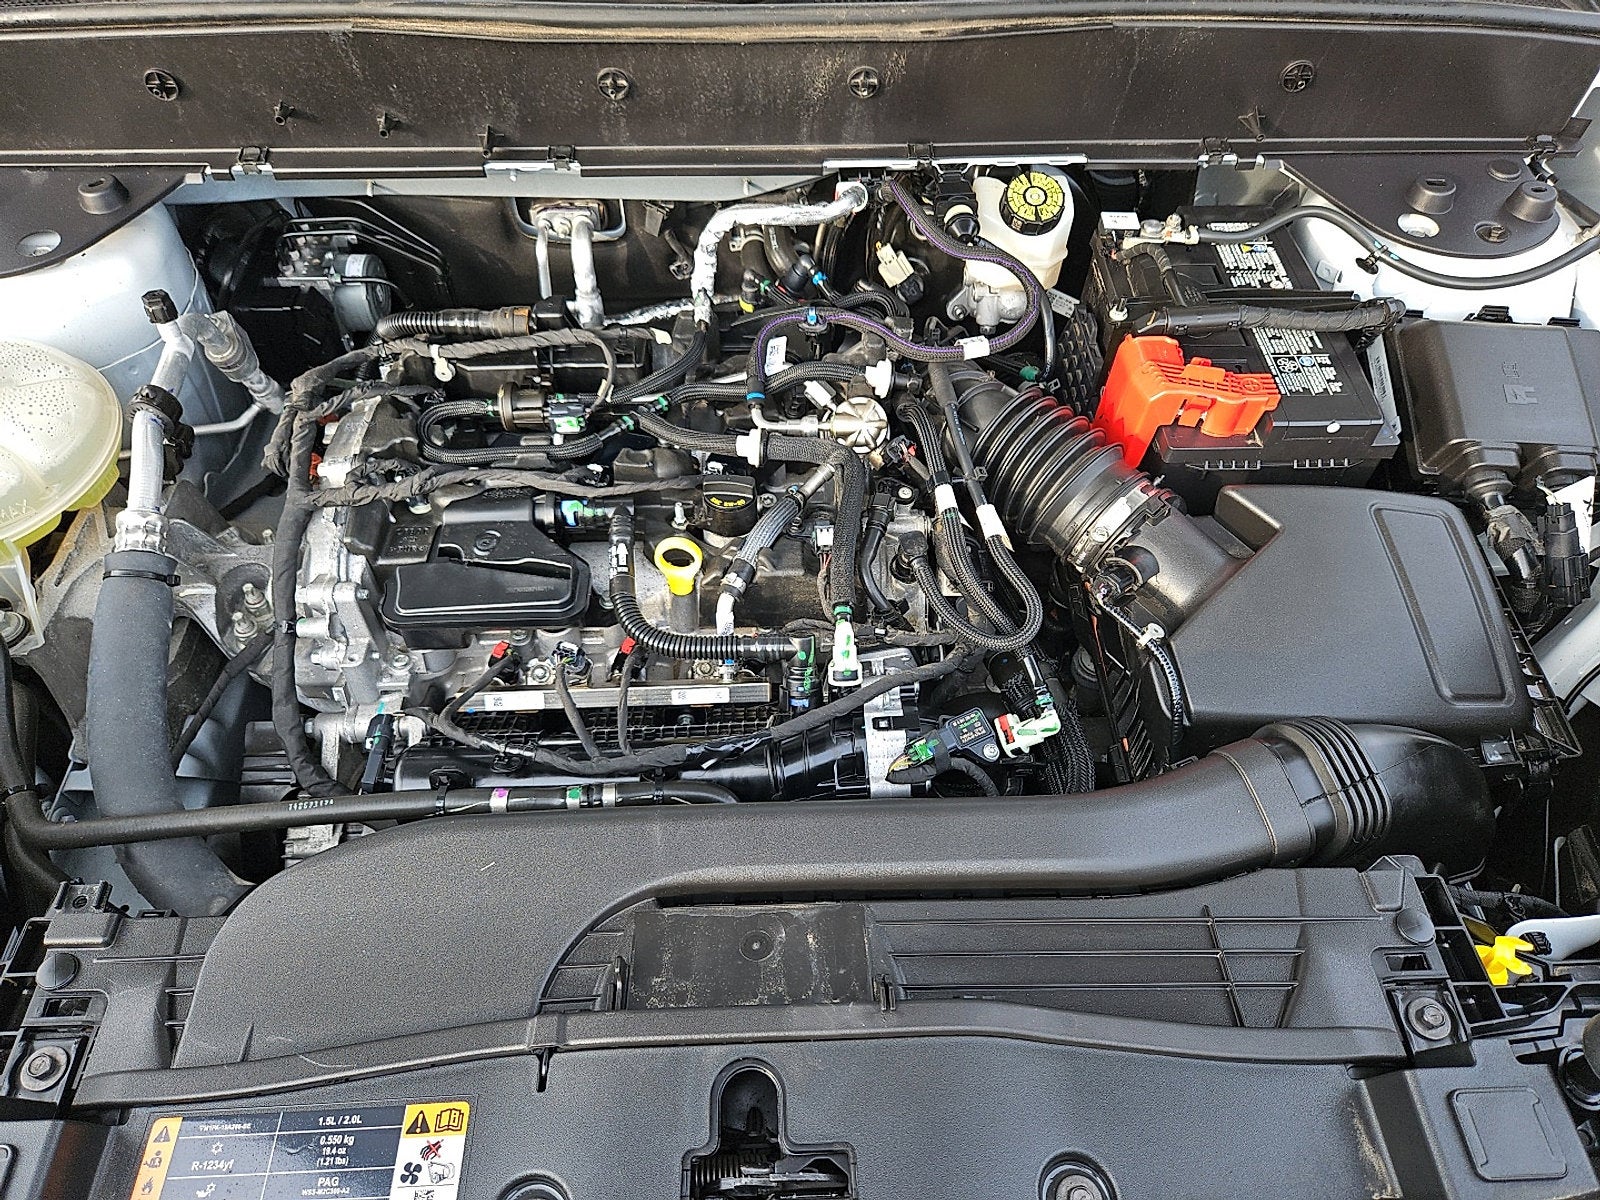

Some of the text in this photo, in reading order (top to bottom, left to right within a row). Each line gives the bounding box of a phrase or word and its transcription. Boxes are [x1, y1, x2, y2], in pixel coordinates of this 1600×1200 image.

[343, 1115, 362, 1125] 2.0L
[320, 1134, 355, 1146] 0.550 kg
[191, 1159, 234, 1171] R-1234yf
[318, 1176, 340, 1187] PAG
